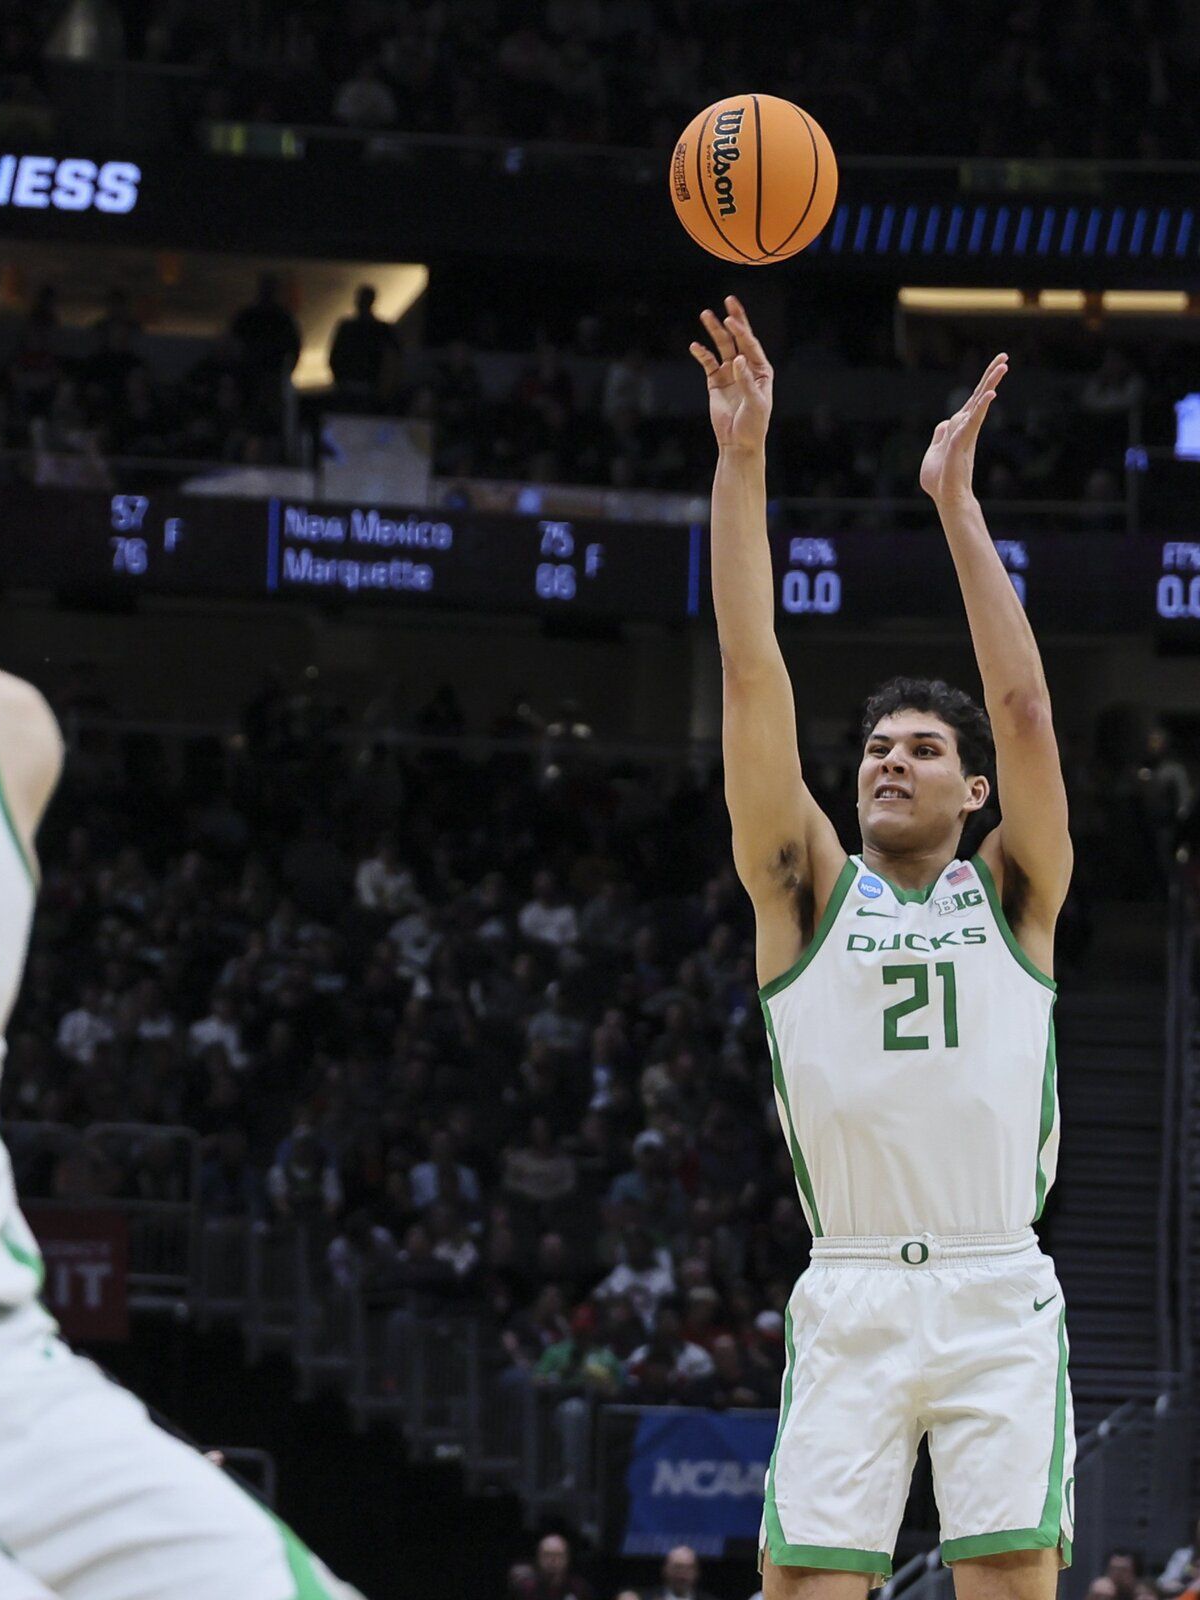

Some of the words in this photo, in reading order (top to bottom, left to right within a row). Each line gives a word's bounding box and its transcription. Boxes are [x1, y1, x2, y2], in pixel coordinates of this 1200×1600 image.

[712, 107, 745, 217] Wilson
[111, 494, 149, 530] 57
[285, 506, 347, 544] New
[351, 508, 453, 550] Mexico
[110, 536, 148, 575] 76
[539, 521, 574, 558] 75
[283, 547, 434, 592] Marquette
[782, 570, 842, 614] 0.0
[847, 927, 988, 953] DUCKS
[882, 961, 959, 1051] 21
[900, 1241, 929, 1265] O
